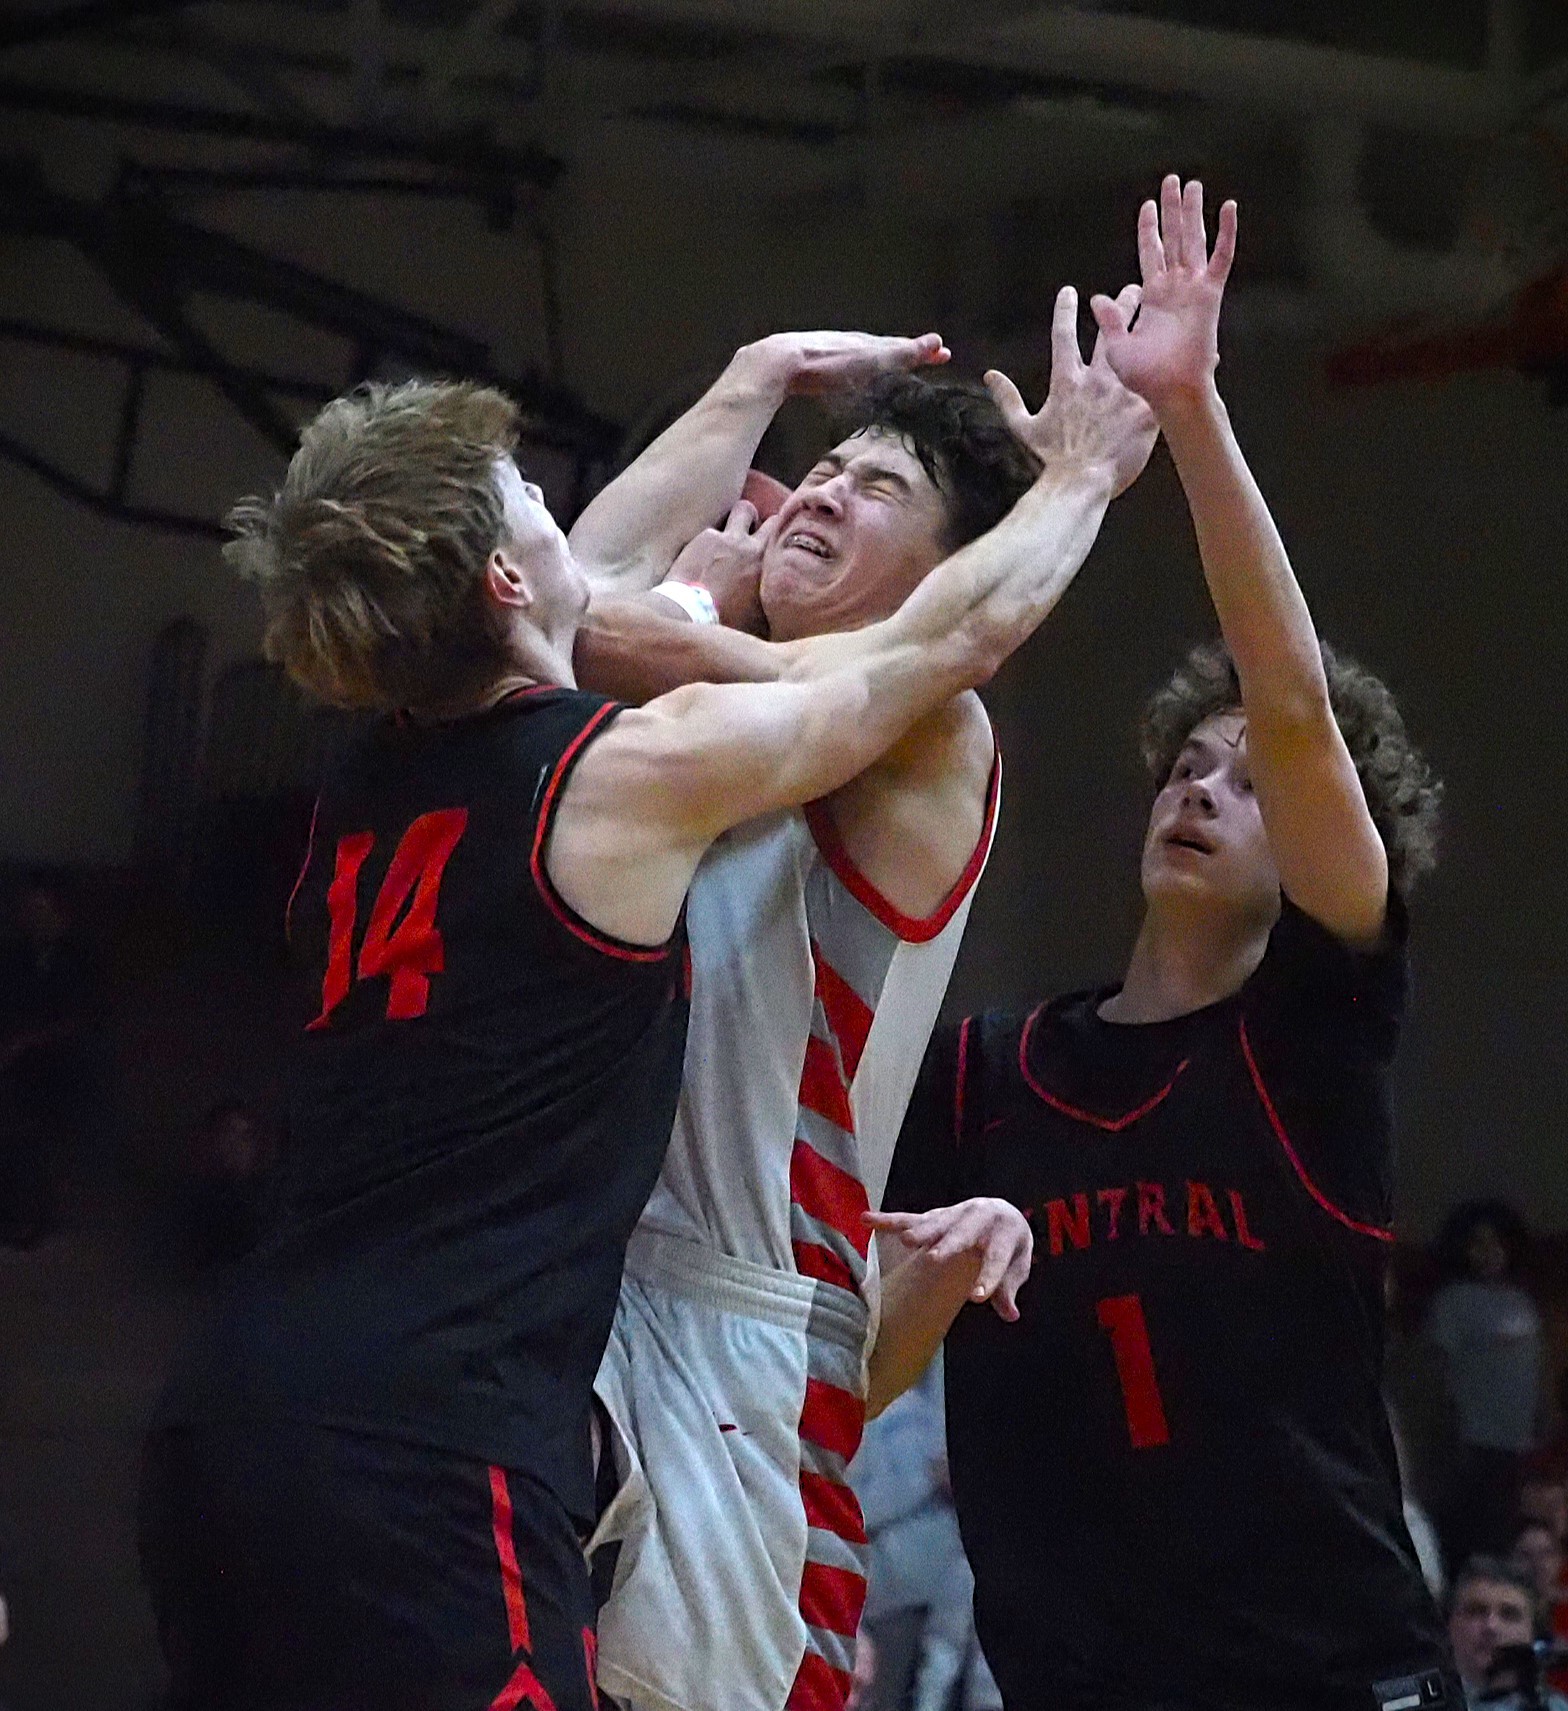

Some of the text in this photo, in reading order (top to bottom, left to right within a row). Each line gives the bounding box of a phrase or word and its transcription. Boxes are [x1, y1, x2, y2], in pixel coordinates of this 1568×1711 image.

[304, 806, 469, 1032] 14
[1026, 1179, 1266, 1258] NTRAL
[1097, 1292, 1170, 1449] 1
